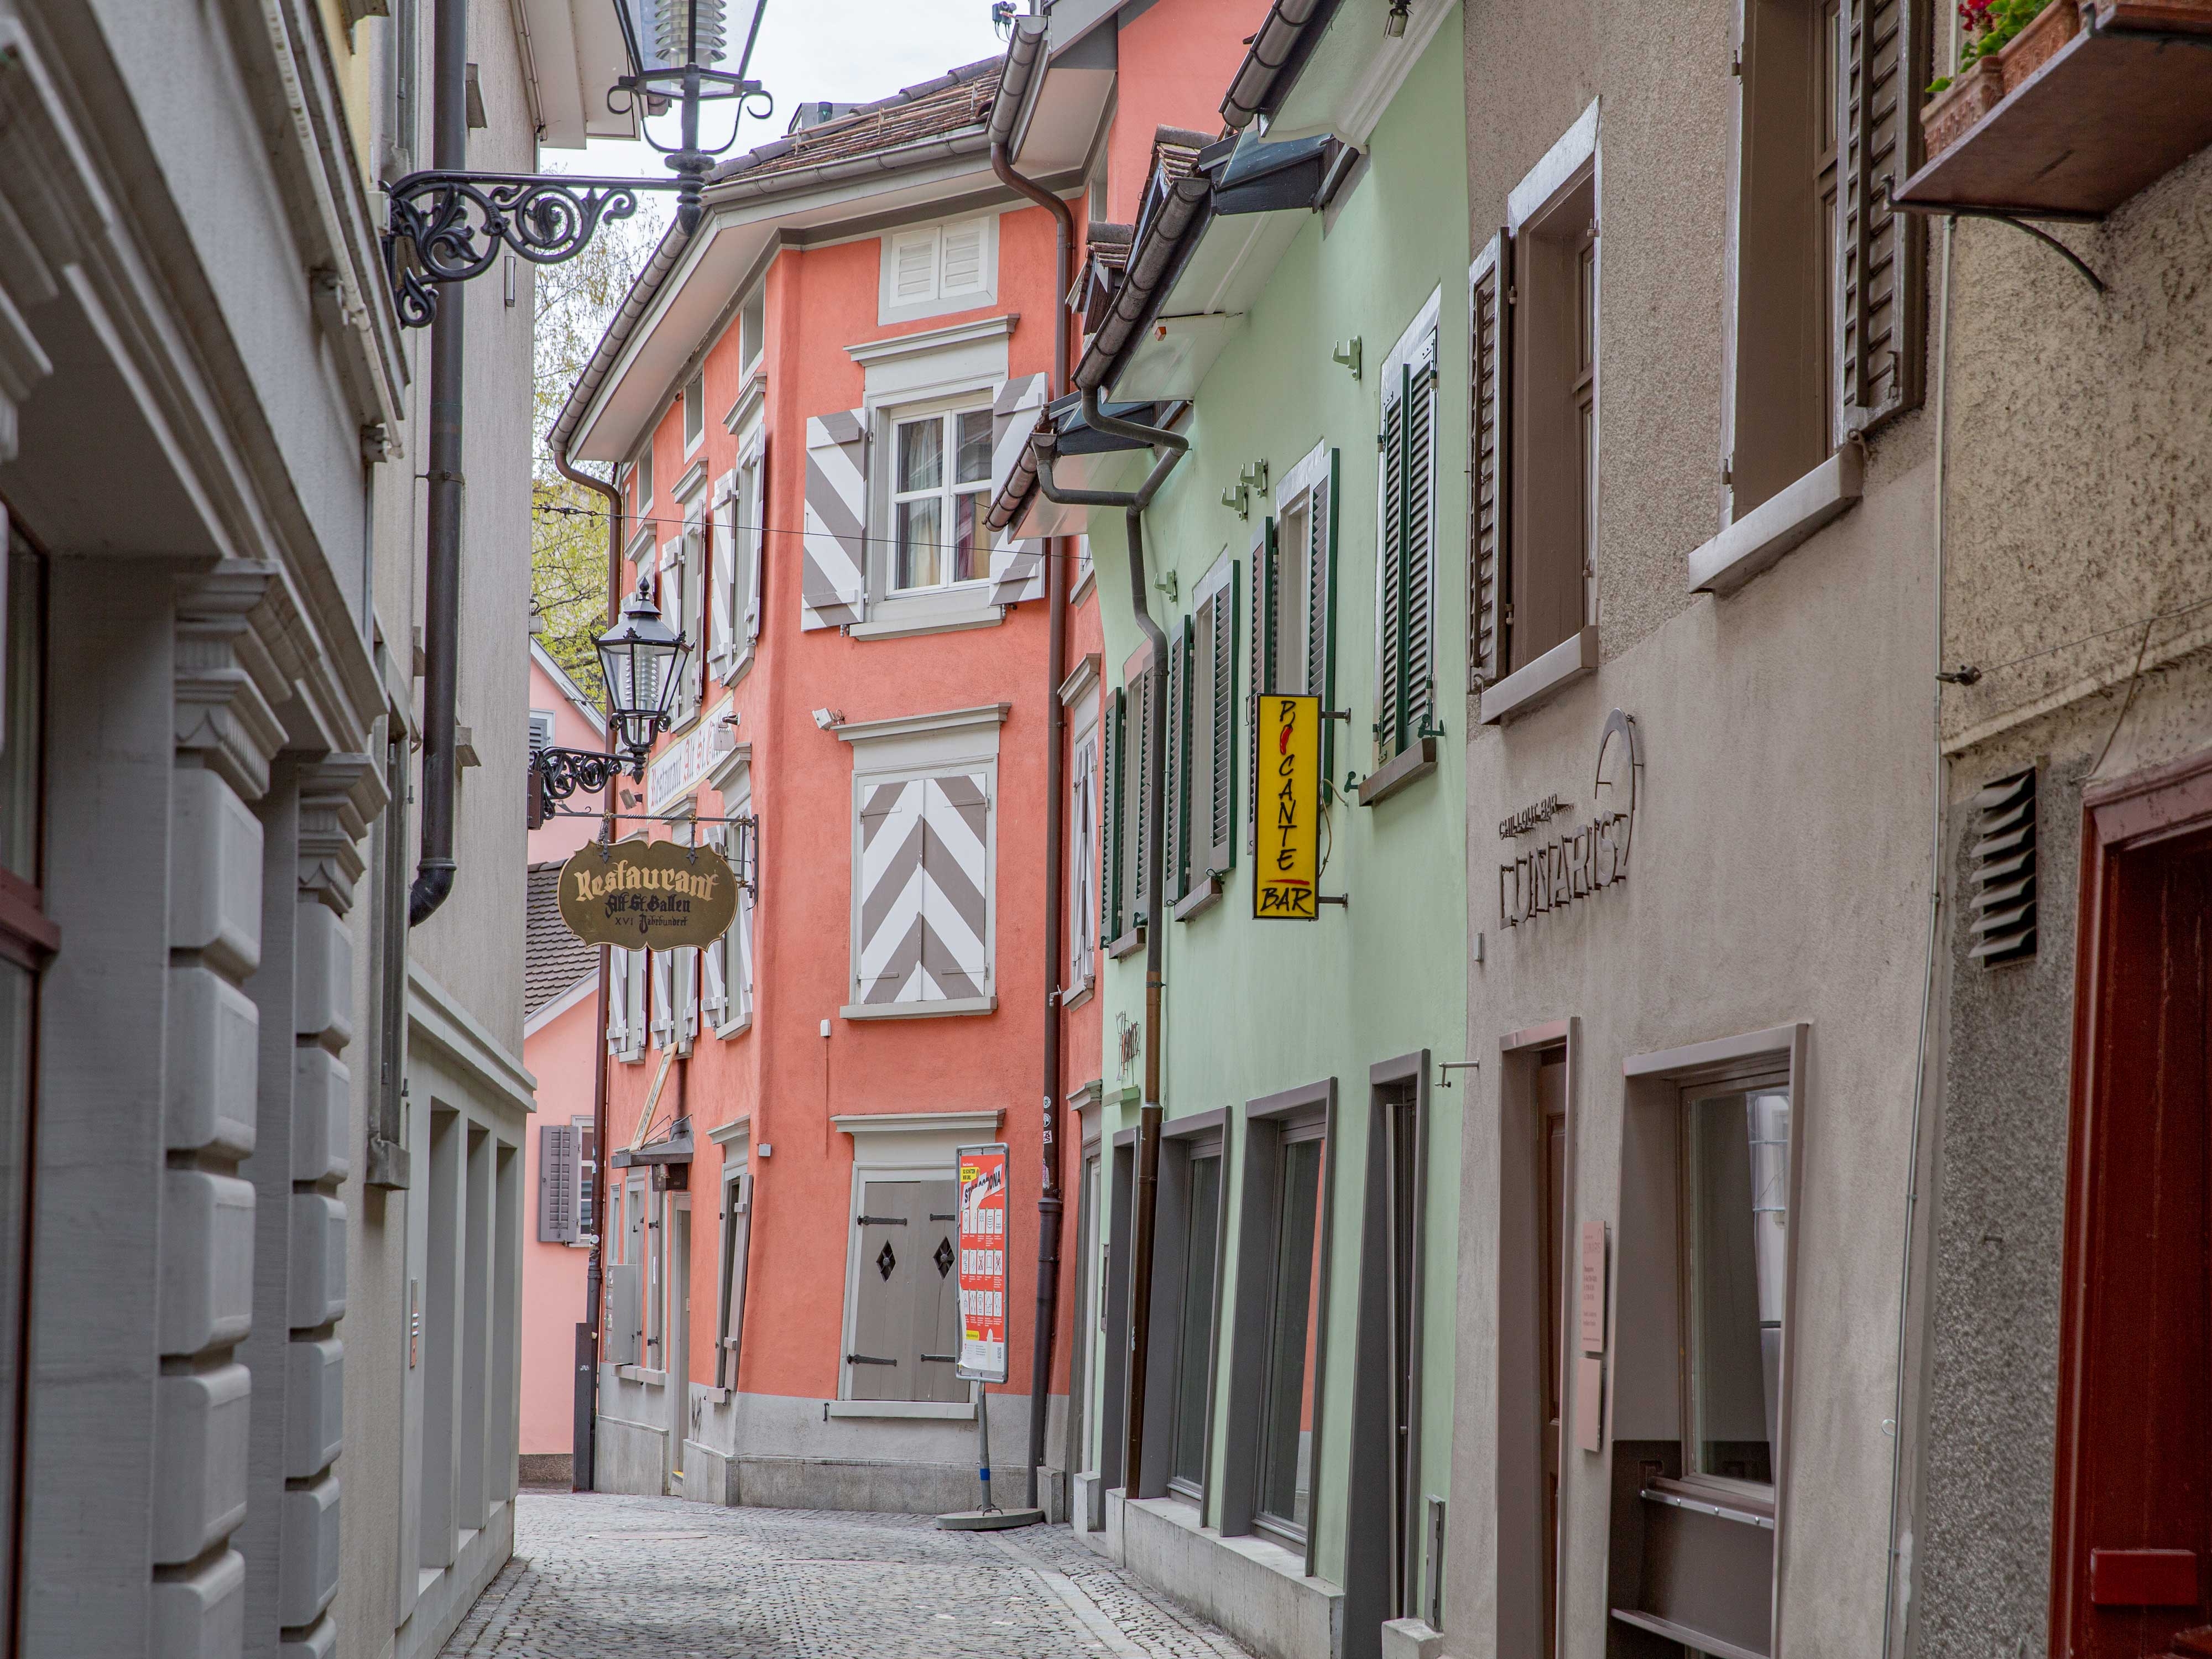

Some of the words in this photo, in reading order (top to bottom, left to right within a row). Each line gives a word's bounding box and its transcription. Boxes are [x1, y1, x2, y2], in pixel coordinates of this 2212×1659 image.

[1277, 700, 1297, 871] PICANTE
[574, 859, 720, 902] Restaurant
[1500, 809, 1618, 930] LUNARIS
[604, 891, 629, 919] Alt
[1260, 887, 1313, 915] BAR
[615, 917, 633, 926] XVI
